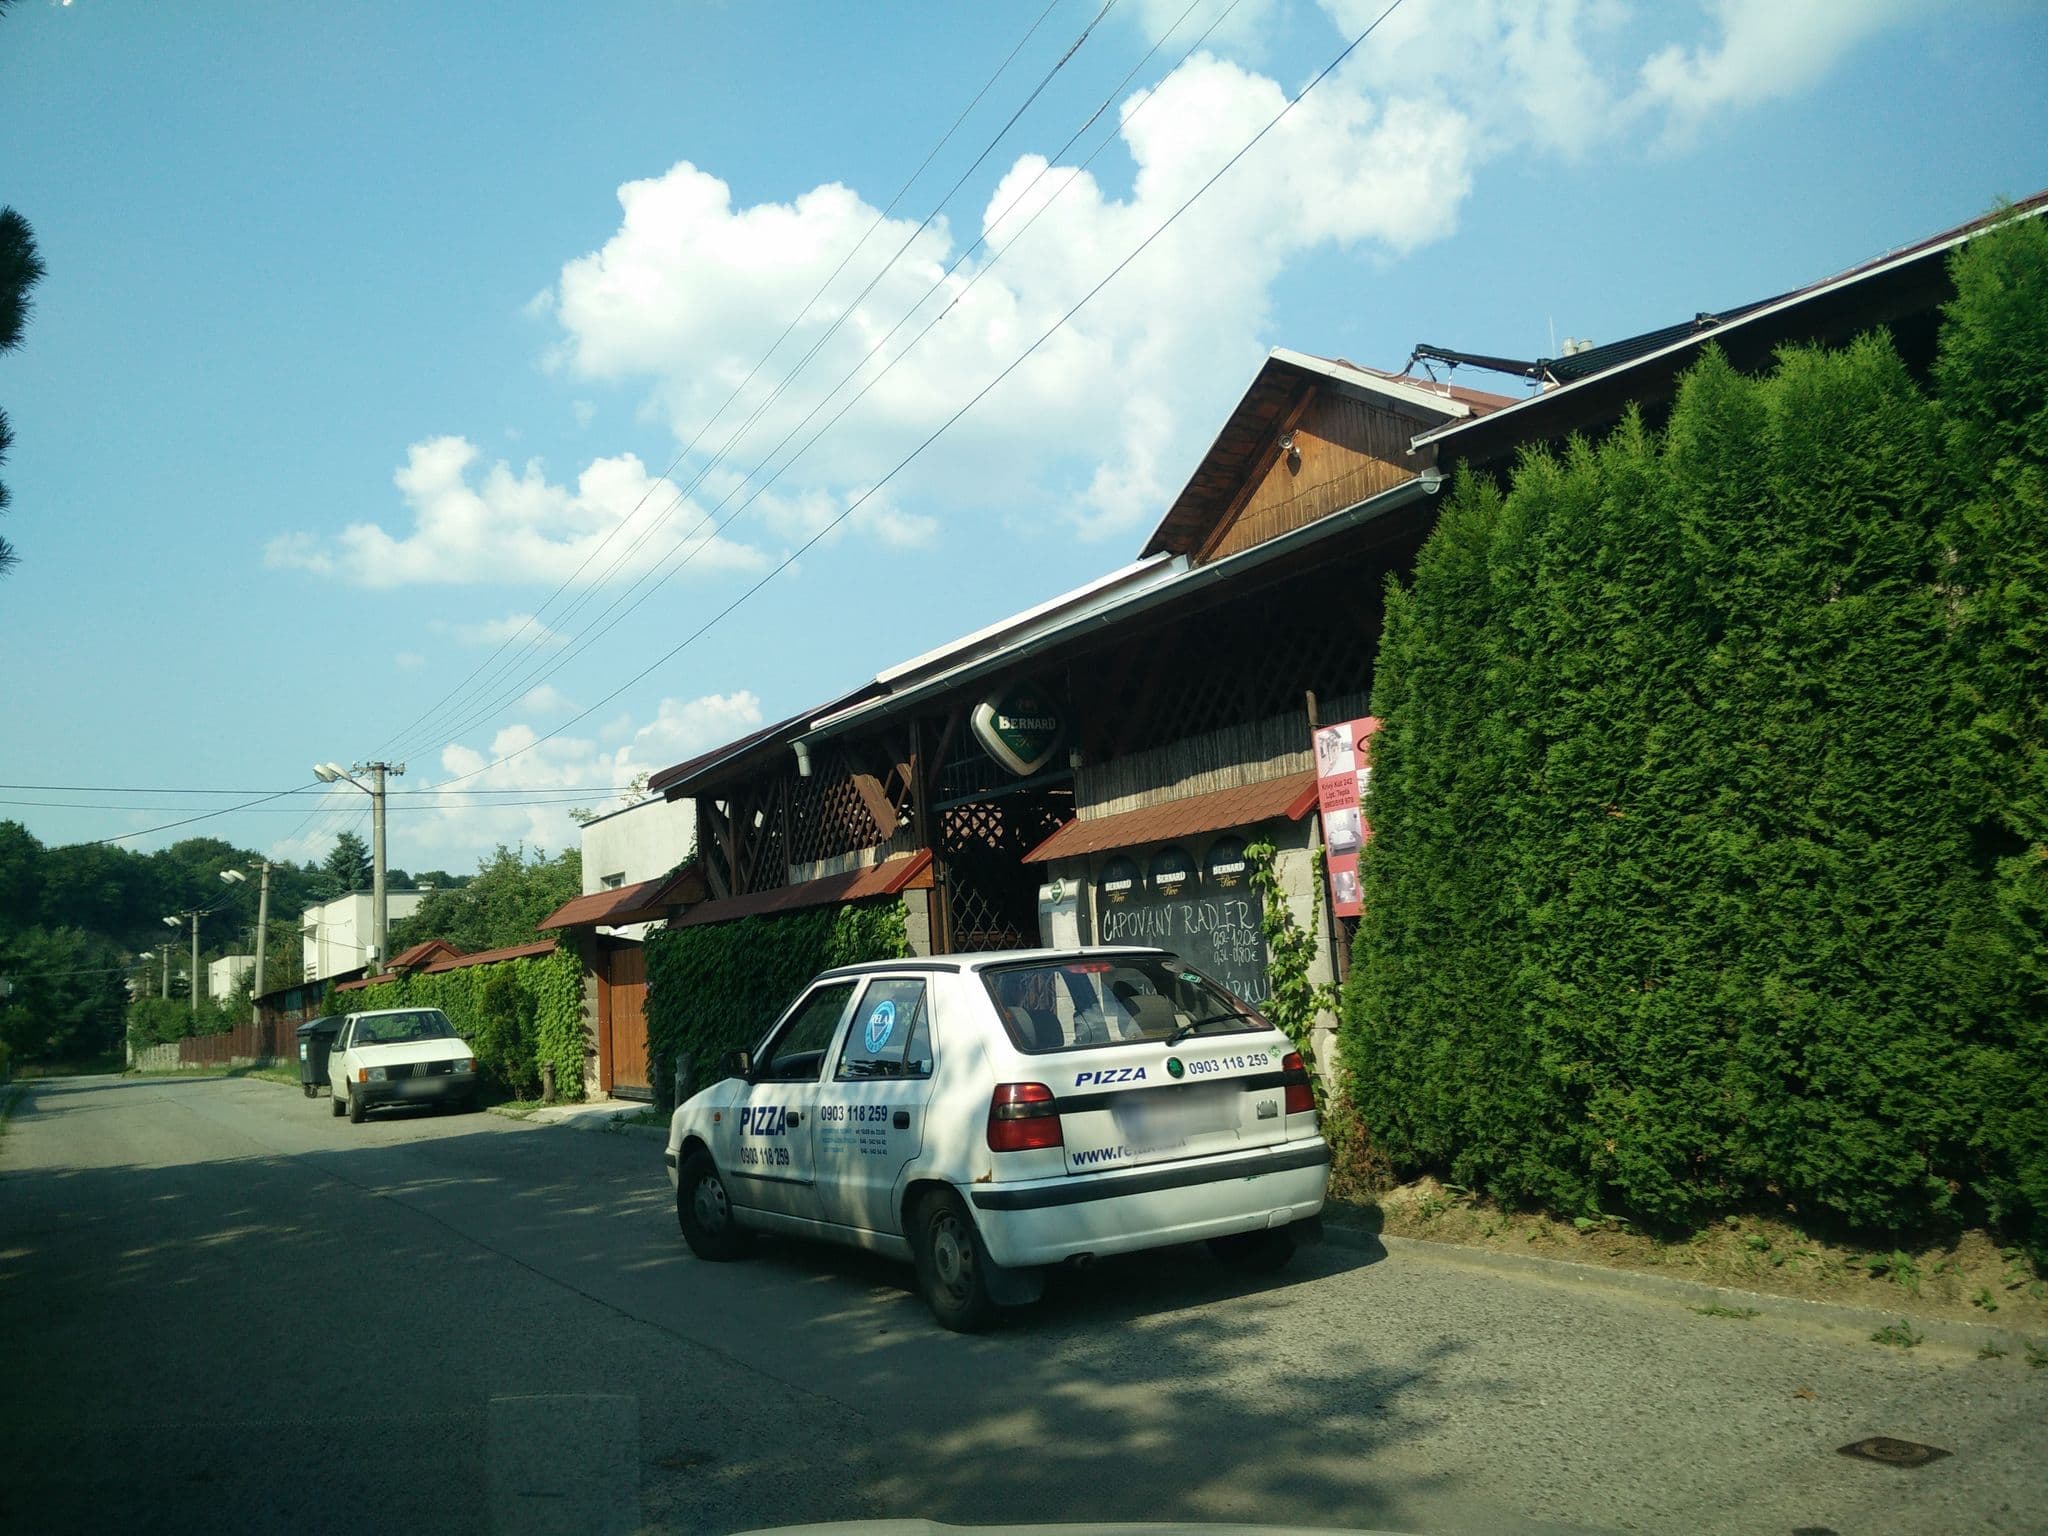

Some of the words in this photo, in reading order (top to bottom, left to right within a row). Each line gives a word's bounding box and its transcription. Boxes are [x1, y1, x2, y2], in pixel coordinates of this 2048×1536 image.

[999, 716, 1056, 730] BERNARD
[1213, 862, 1245, 875] BERNARD
[1156, 871, 1186, 884] BERNARD
[1105, 879, 1132, 892] BERNARD
[1075, 1067, 1147, 1087] PIZZA
[1188, 1058, 1220, 1075] 0903
[1222, 1056, 1245, 1071] 118
[1246, 1053, 1269, 1067] 259
[821, 1105, 844, 1121] 0903
[847, 1105, 866, 1121] 118
[868, 1105, 888, 1121] 259
[739, 1106, 786, 1136] PIZZA
[740, 1147, 759, 1165] 0903
[759, 1147, 774, 1166] 118
[774, 1147, 790, 1166] 259
